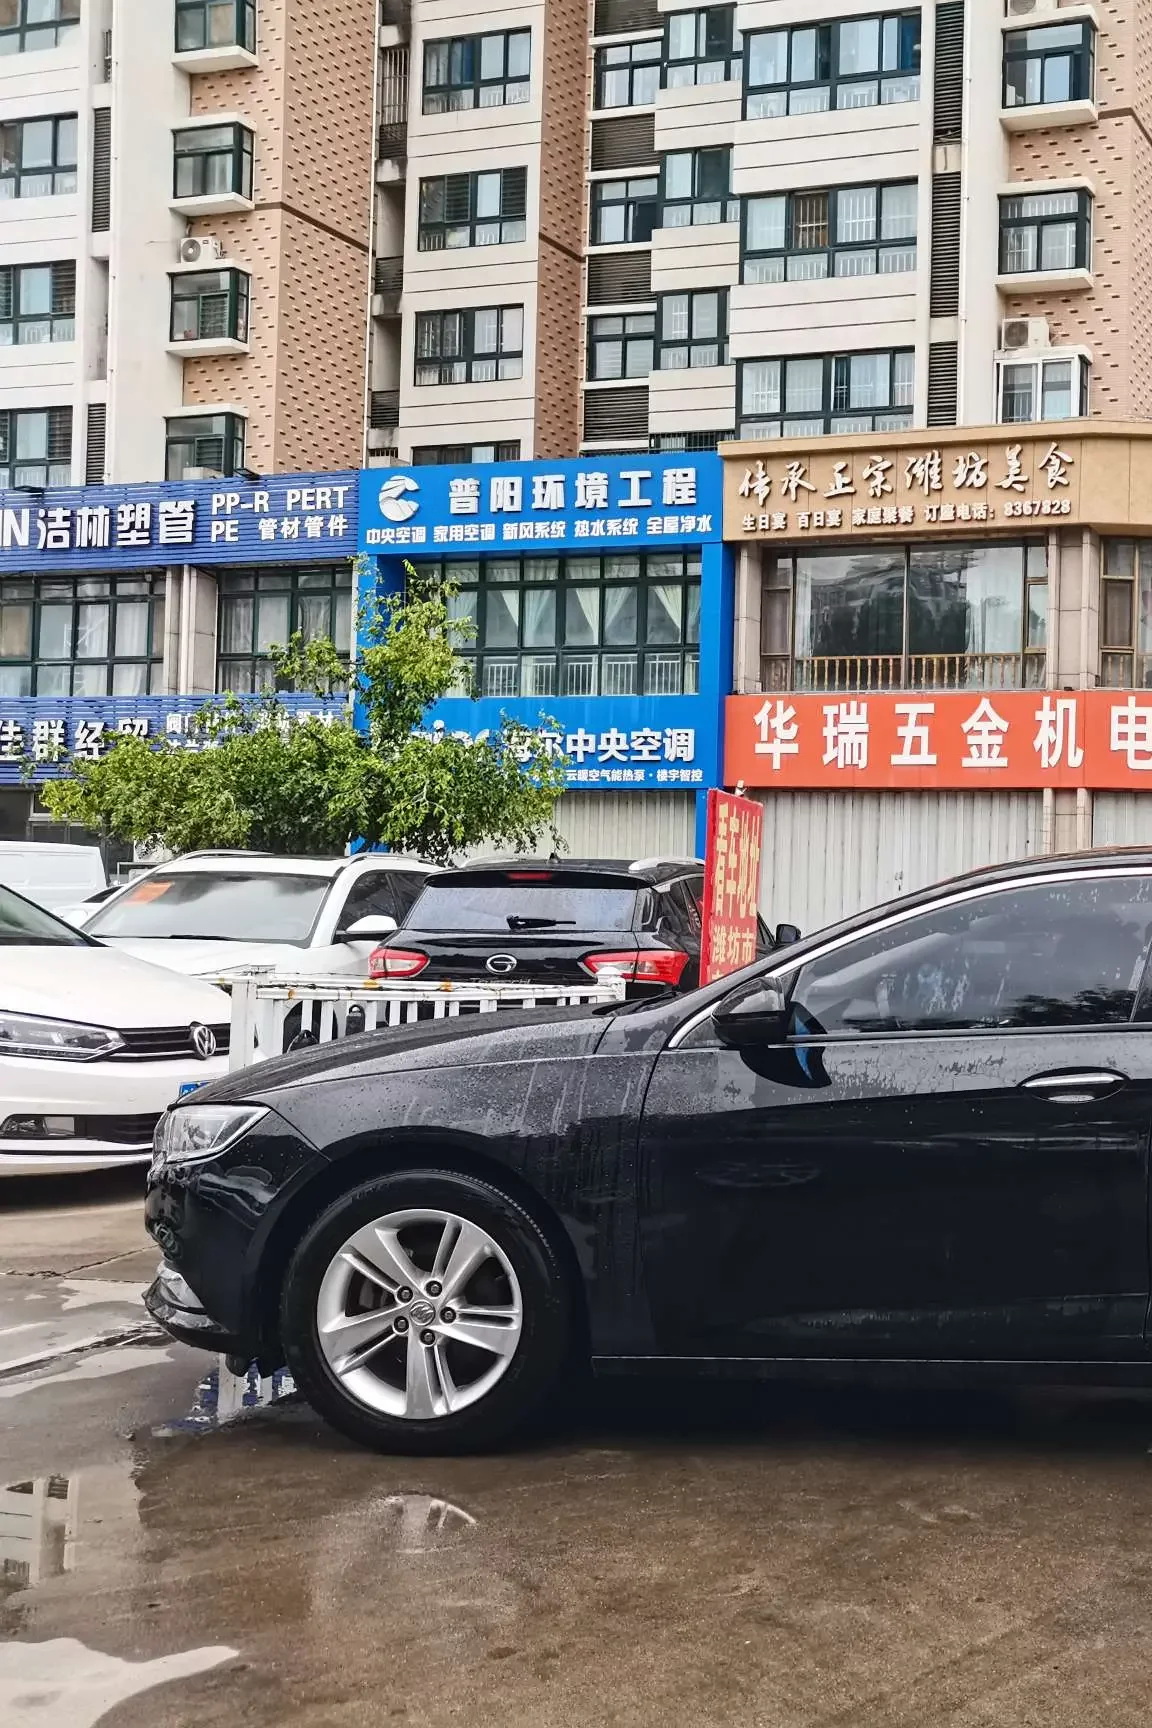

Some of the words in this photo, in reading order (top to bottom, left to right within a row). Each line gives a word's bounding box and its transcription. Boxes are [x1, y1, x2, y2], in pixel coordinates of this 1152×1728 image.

[738, 441, 1076, 506] 传承正宗潍坊美食
[211, 491, 270, 515] PP-R
[286, 487, 350, 510] PERT
[449, 467, 698, 515] 普阳环境工程
[211, 520, 239, 543] PE
[259, 514, 349, 541] 管材管件
[366, 526, 426, 545] 中央空调
[433, 524, 496, 543] 家用空调
[503, 522, 567, 541] 新风系统
[574, 518, 639, 538] 热水系统
[647, 515, 713, 535] 全屋净水
[742, 511, 788, 532] 生日宴
[795, 508, 842, 530] 百日宴
[851, 504, 915, 527] 家庭聚餐
[1004, 500, 1072, 516] 8367828
[711, 924, 755, 966] 潍坊市
